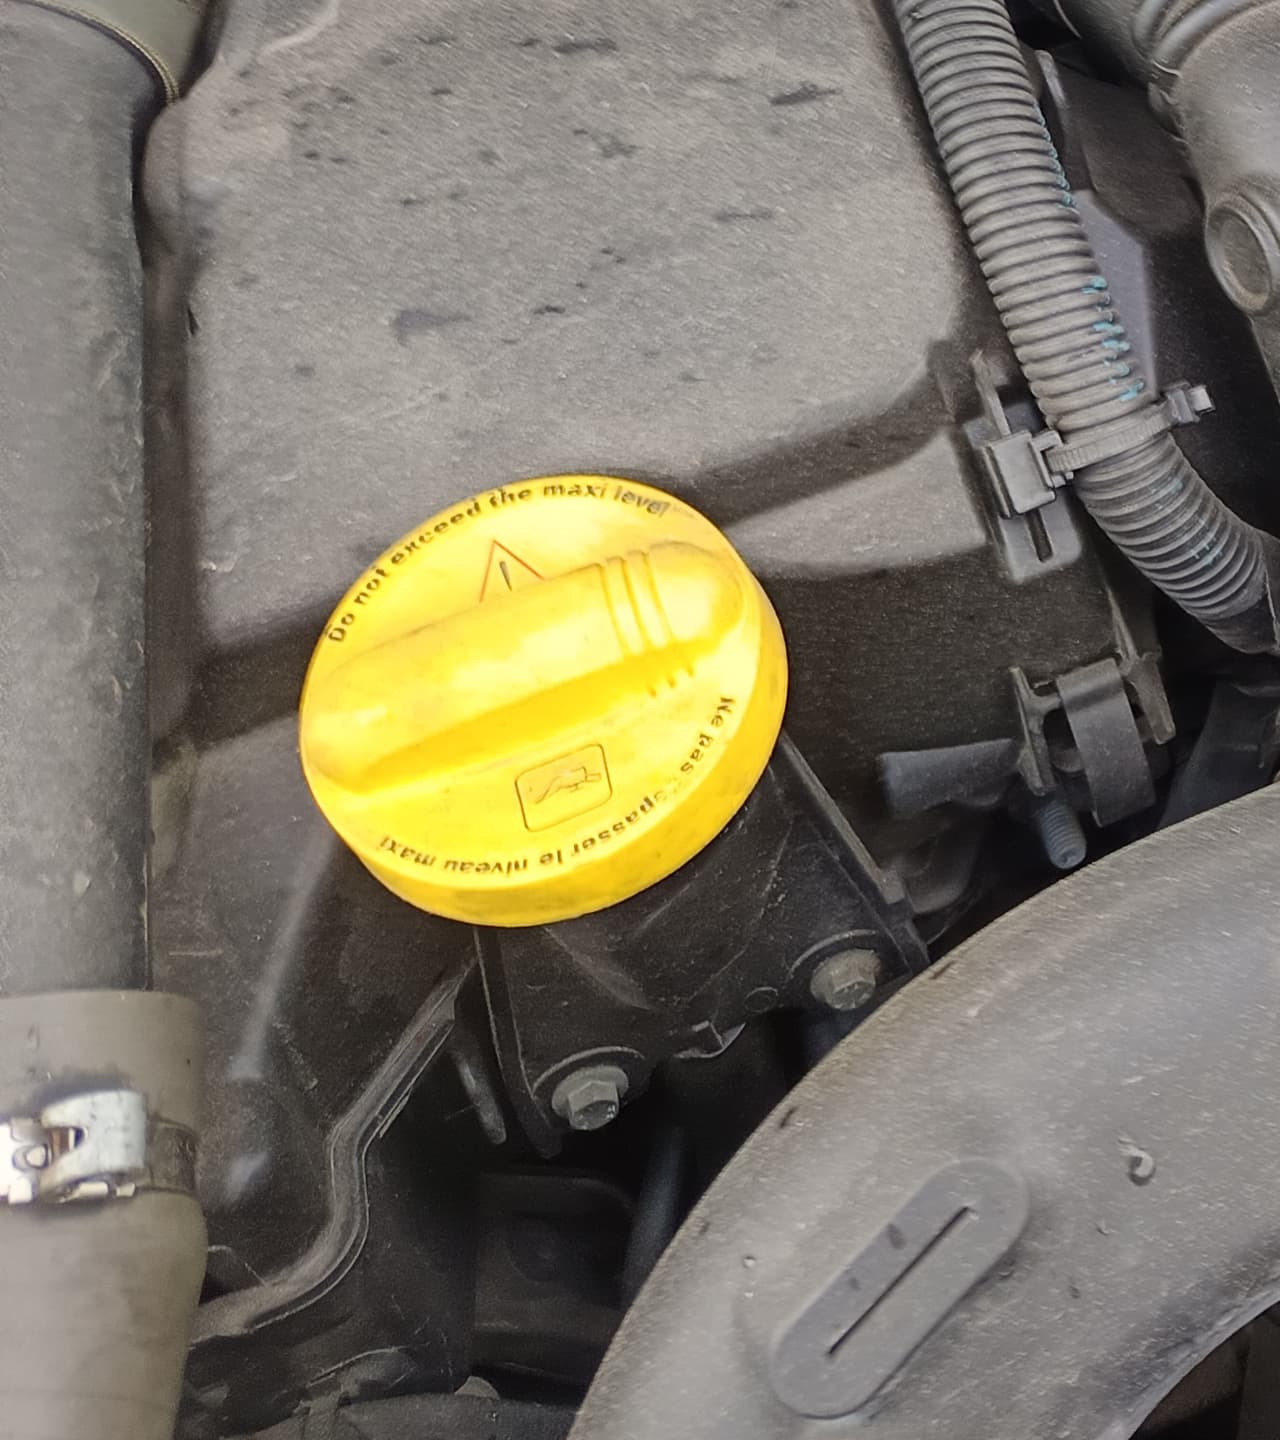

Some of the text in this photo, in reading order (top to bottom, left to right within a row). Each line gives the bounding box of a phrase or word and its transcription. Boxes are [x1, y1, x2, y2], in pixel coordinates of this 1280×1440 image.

[328, 483, 672, 642] Do not exceed the maxi level
[711, 697, 735, 727] Ne
[680, 733, 713, 774] pas
[379, 836, 437, 867] maxi
[539, 849, 564, 866] le
[444, 859, 528, 878] niveau
